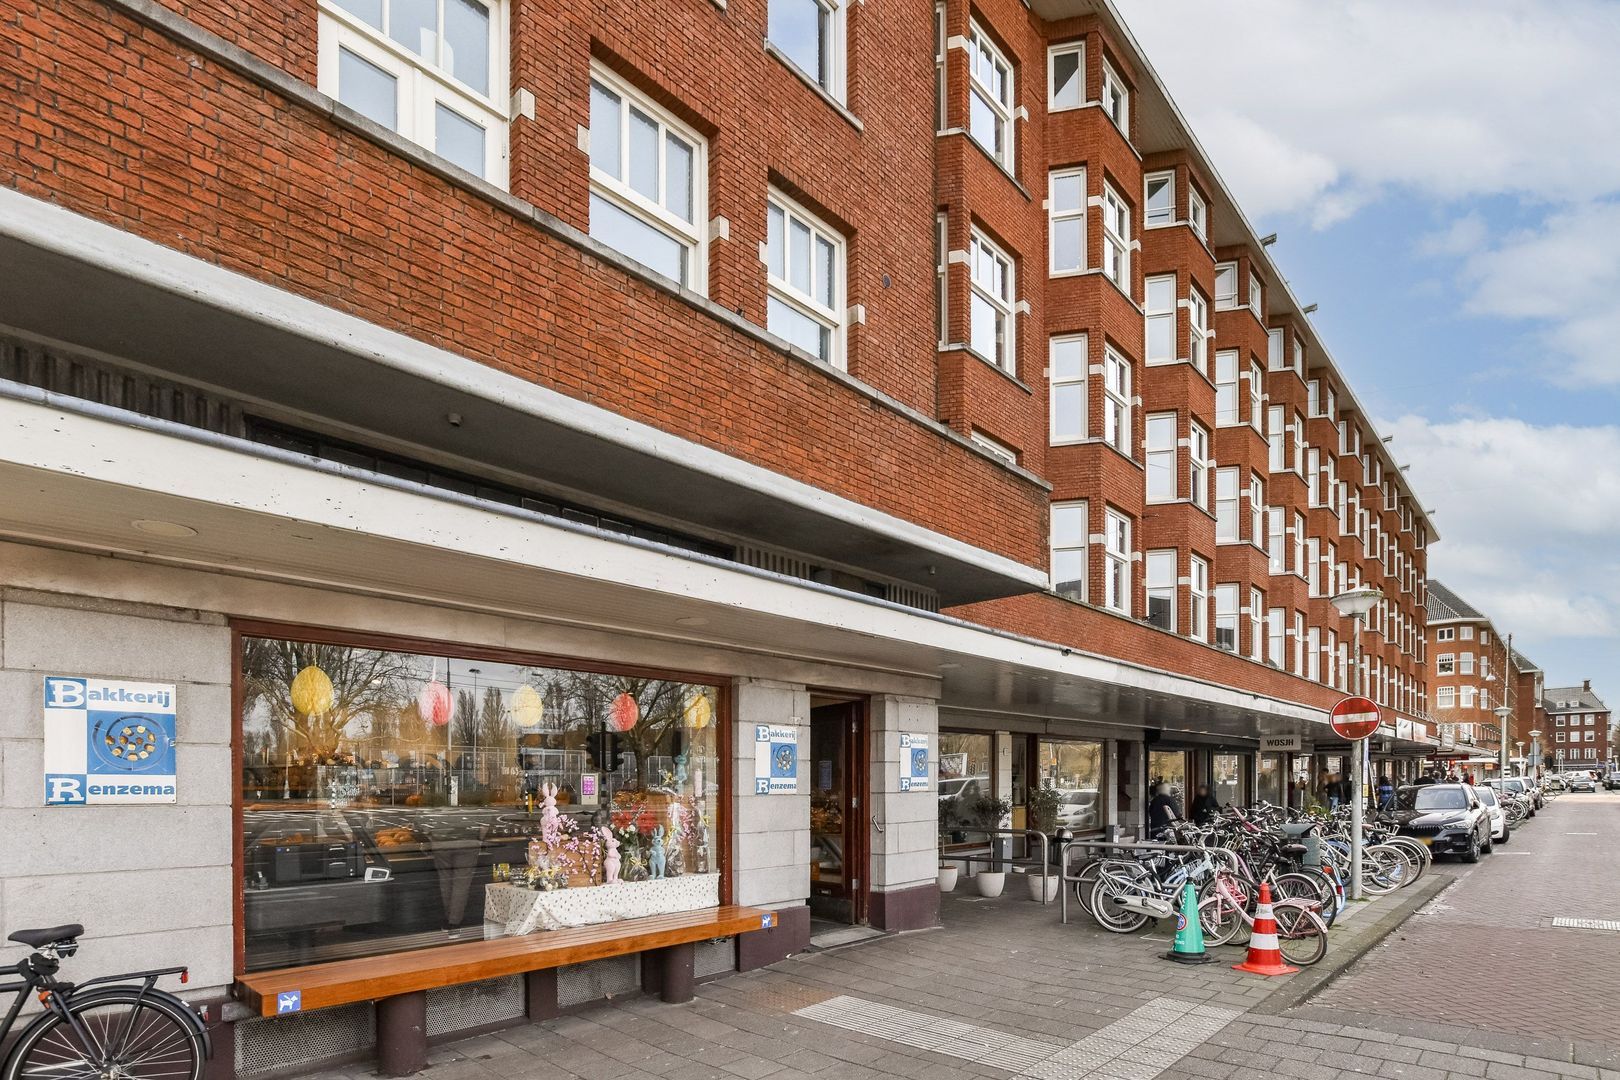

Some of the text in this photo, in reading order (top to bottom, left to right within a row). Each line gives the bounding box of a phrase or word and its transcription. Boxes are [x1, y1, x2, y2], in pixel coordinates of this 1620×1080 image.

[48, 679, 170, 708] Bakkerij
[757, 726, 796, 741] Bakkerij
[48, 777, 175, 802] Renzema
